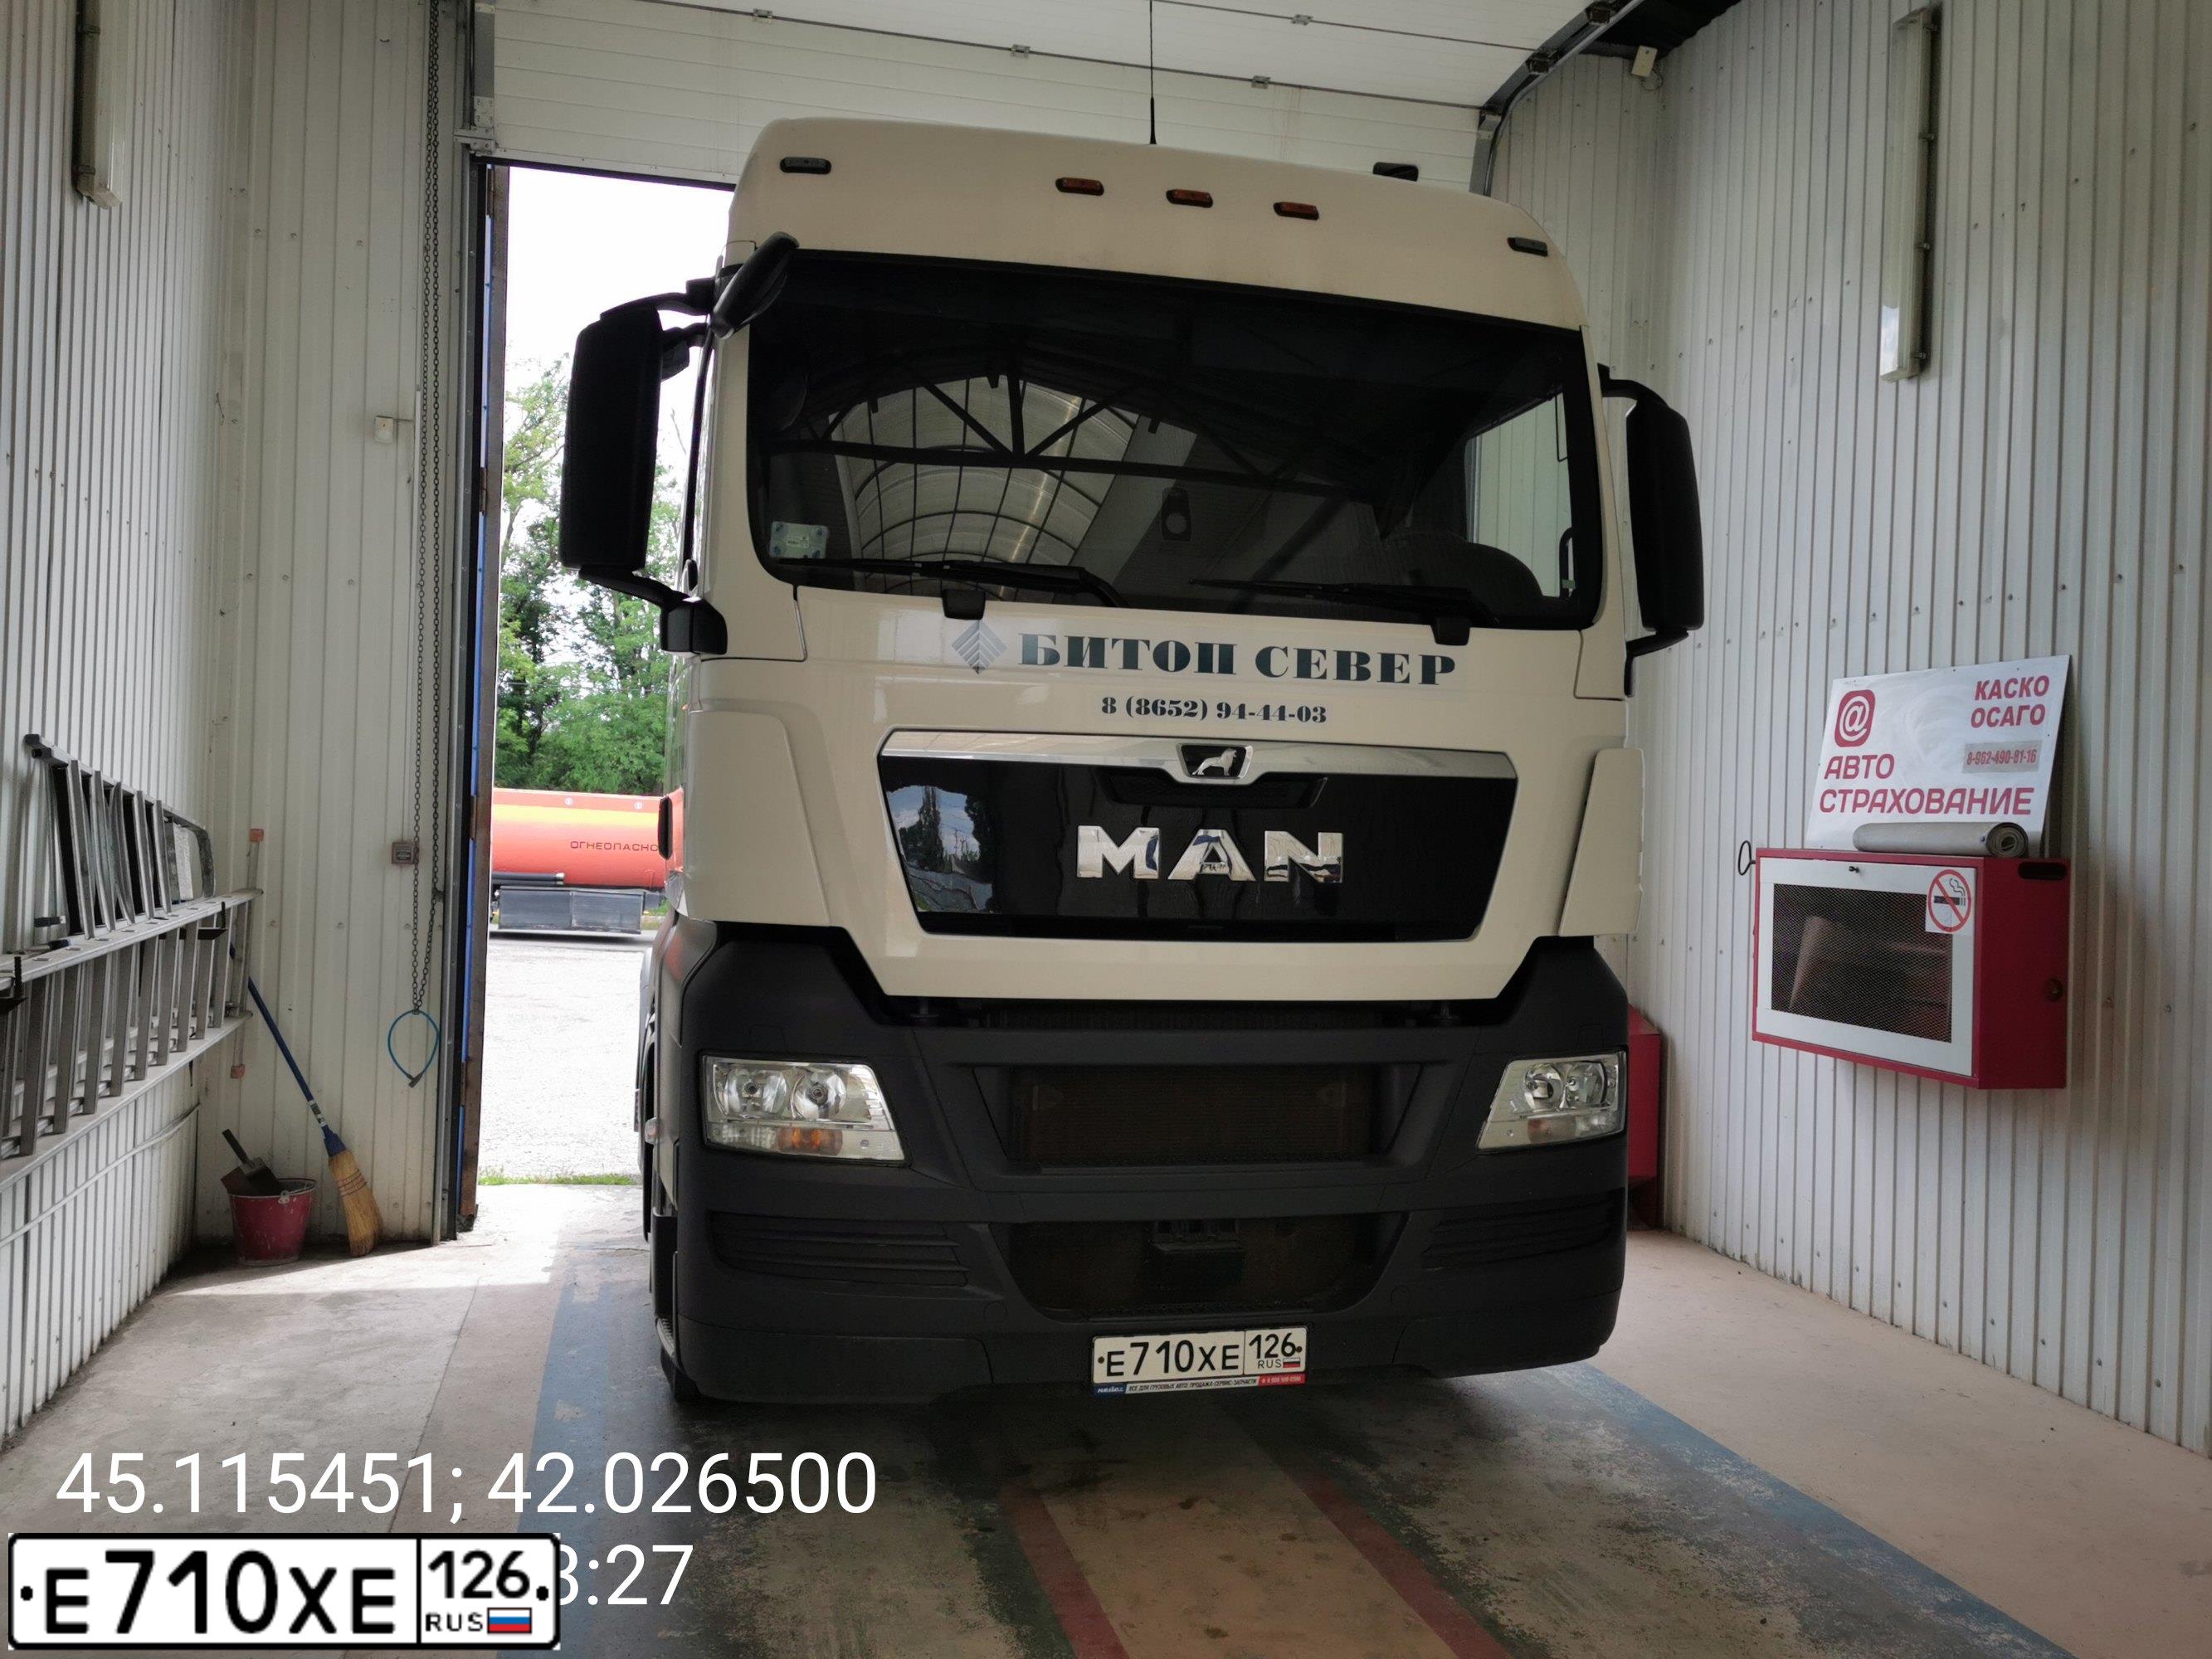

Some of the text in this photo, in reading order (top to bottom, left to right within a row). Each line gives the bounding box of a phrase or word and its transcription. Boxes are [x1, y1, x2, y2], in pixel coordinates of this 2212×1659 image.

[1017, 633, 1456, 686] БИТОП СЕВЕР
[1975, 675, 2050, 701] КАСКО
[1101, 695, 1328, 723] 8 (8652) 94-44-03
[1971, 703, 2046, 729] ОСАГО
[1824, 753, 1895, 780] АВТО
[1819, 787, 2035, 815] СТРАХОВАНИЕ
[570, 840, 658, 852] ОГНЕОПАСНО
[1077, 825, 1344, 883] MAN
[1106, 1333, 1296, 1377] Е710ХЕ 126
[1258, 1359, 1282, 1369] RUS
